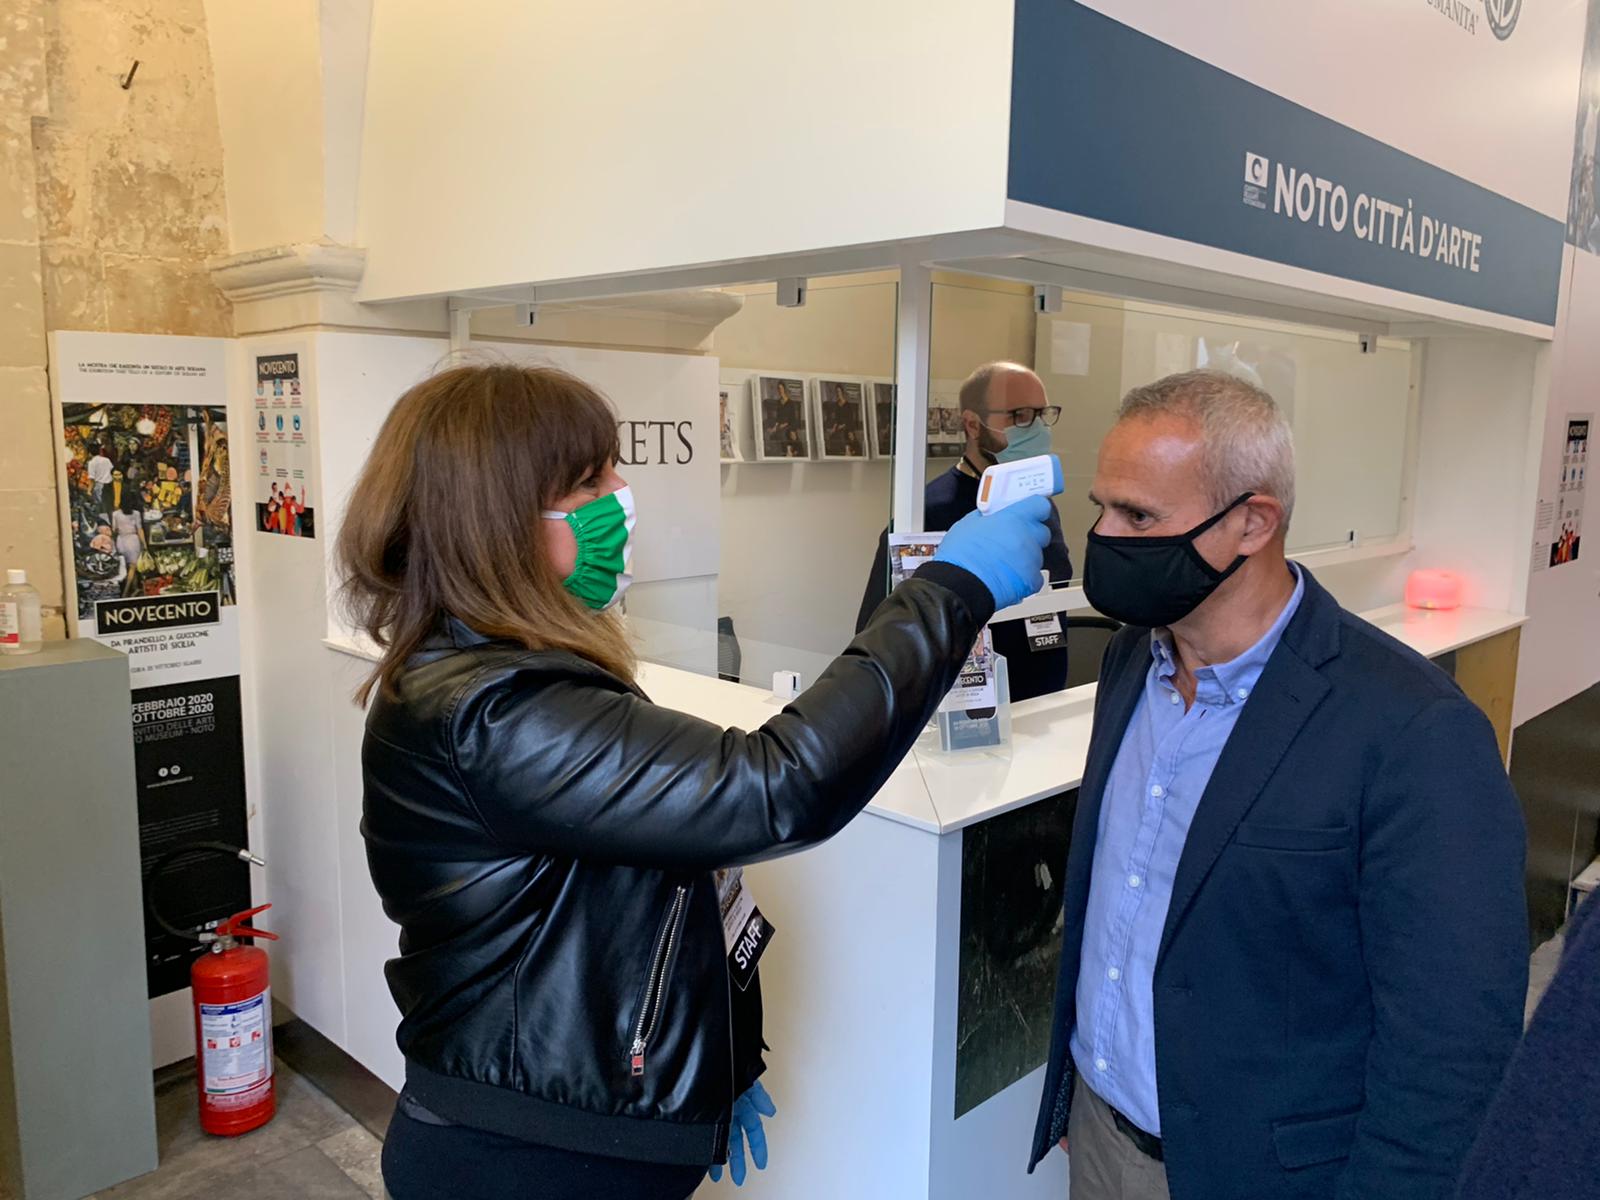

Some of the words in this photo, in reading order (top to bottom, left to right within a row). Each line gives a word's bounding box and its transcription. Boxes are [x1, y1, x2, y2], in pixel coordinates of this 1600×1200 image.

[1426, 0, 1479, 35] ANITA'
[1273, 162, 1348, 233] NOTO
[1353, 198, 1415, 254] CITTÀ
[1419, 215, 1483, 273] D'ARTE
[258, 360, 296, 375] NOVECENTO
[105, 600, 212, 627] NOVECENTO
[111, 640, 120, 648] DA
[128, 644, 158, 655] ARTISTI
[160, 643, 169, 651] DI
[171, 640, 196, 649] SICILIA
[1035, 634, 1059, 646] STAFF
[132, 696, 186, 714] FEBBRAIO
[187, 692, 213, 705] 2020
[133, 706, 186, 723] OTTOBRE
[187, 702, 213, 715] 2020
[166, 719, 193, 730] DELLE
[195, 716, 215, 725] ARTI
[191, 723, 215, 734] NOTO
[735, 919, 762, 970] STAFF
